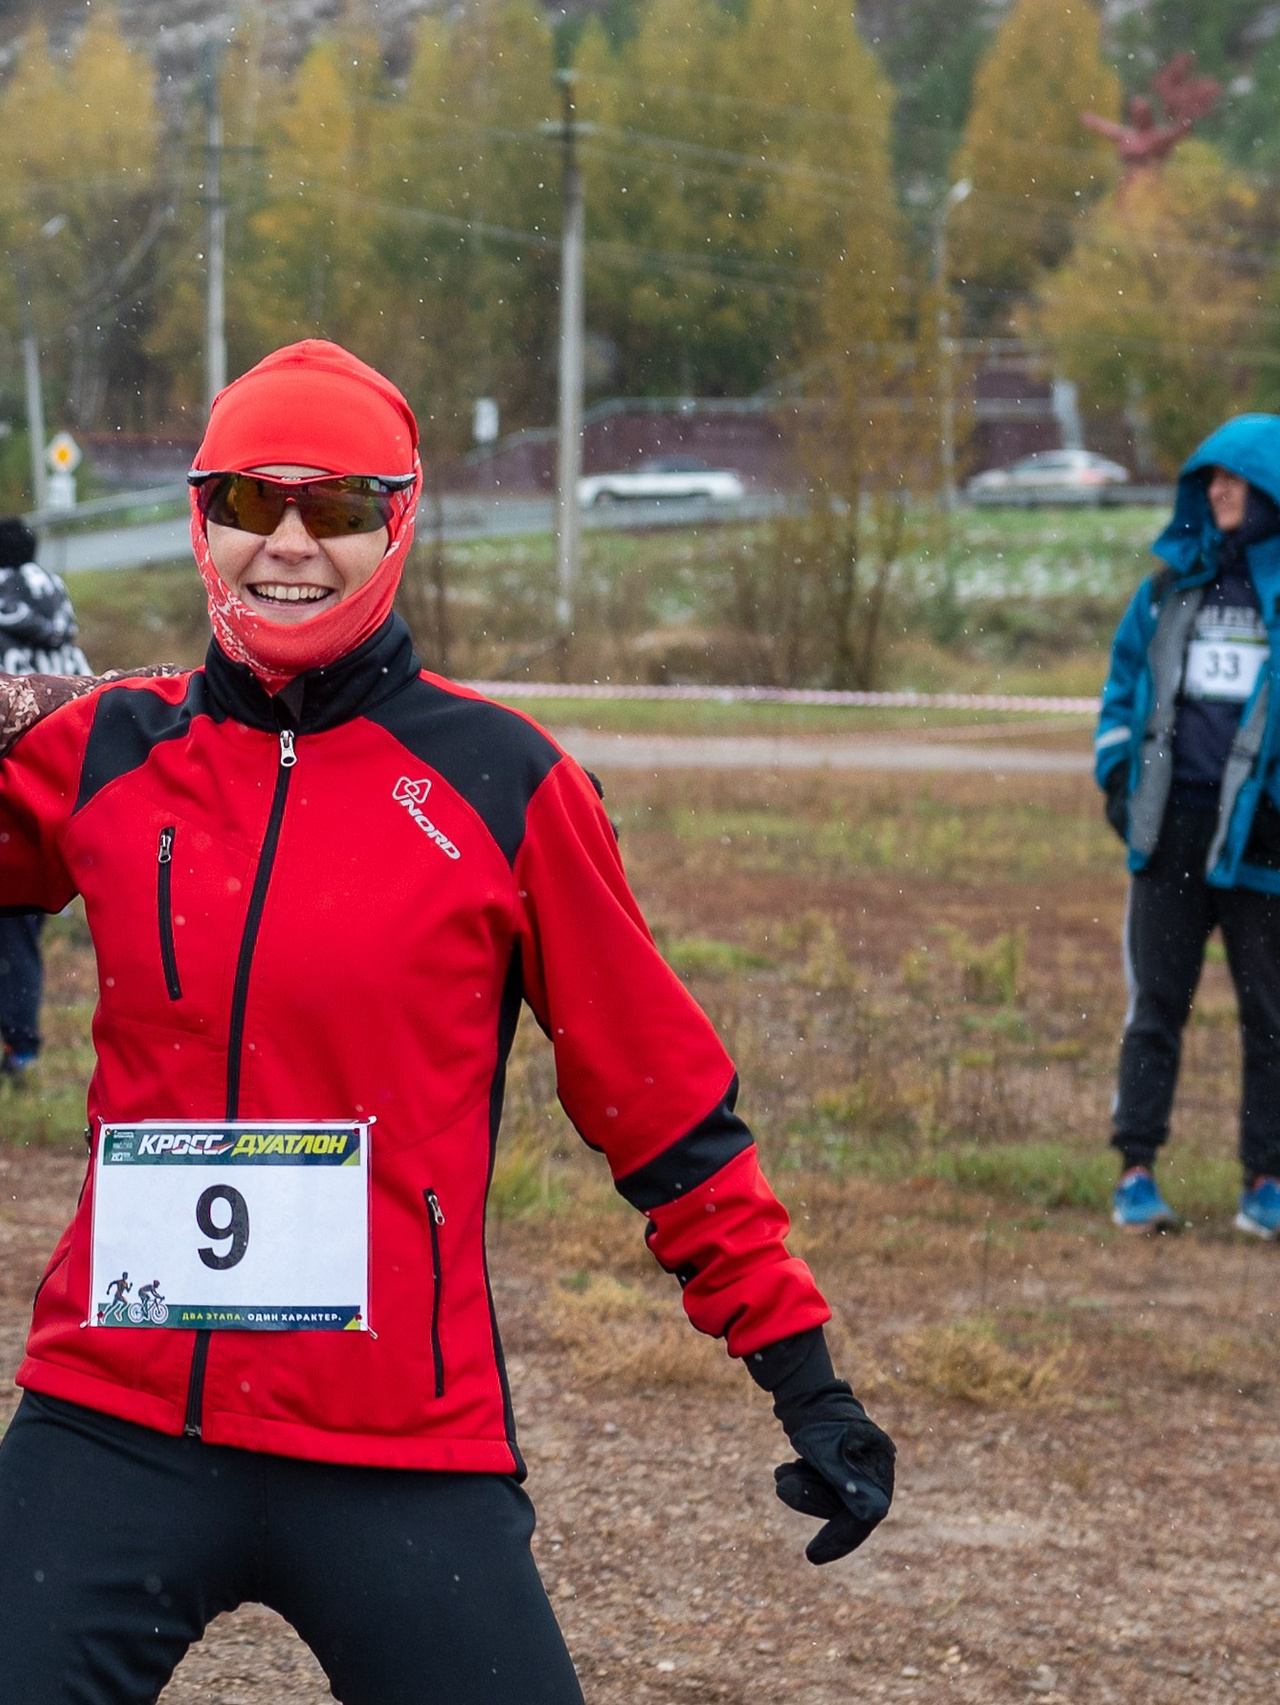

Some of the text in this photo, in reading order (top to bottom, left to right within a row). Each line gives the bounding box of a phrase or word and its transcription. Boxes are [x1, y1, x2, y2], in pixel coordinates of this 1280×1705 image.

[1206, 650, 1240, 680] 33
[400, 799, 461, 860] NORD
[137, 1134, 349, 1157] КРОСС ДУАТЛОН
[196, 1184, 250, 1270] 9
[182, 1312, 203, 1321] ДВА
[247, 1313, 279, 1322] ОДИН
[281, 1313, 343, 1322] ХАРАКТЕР.
